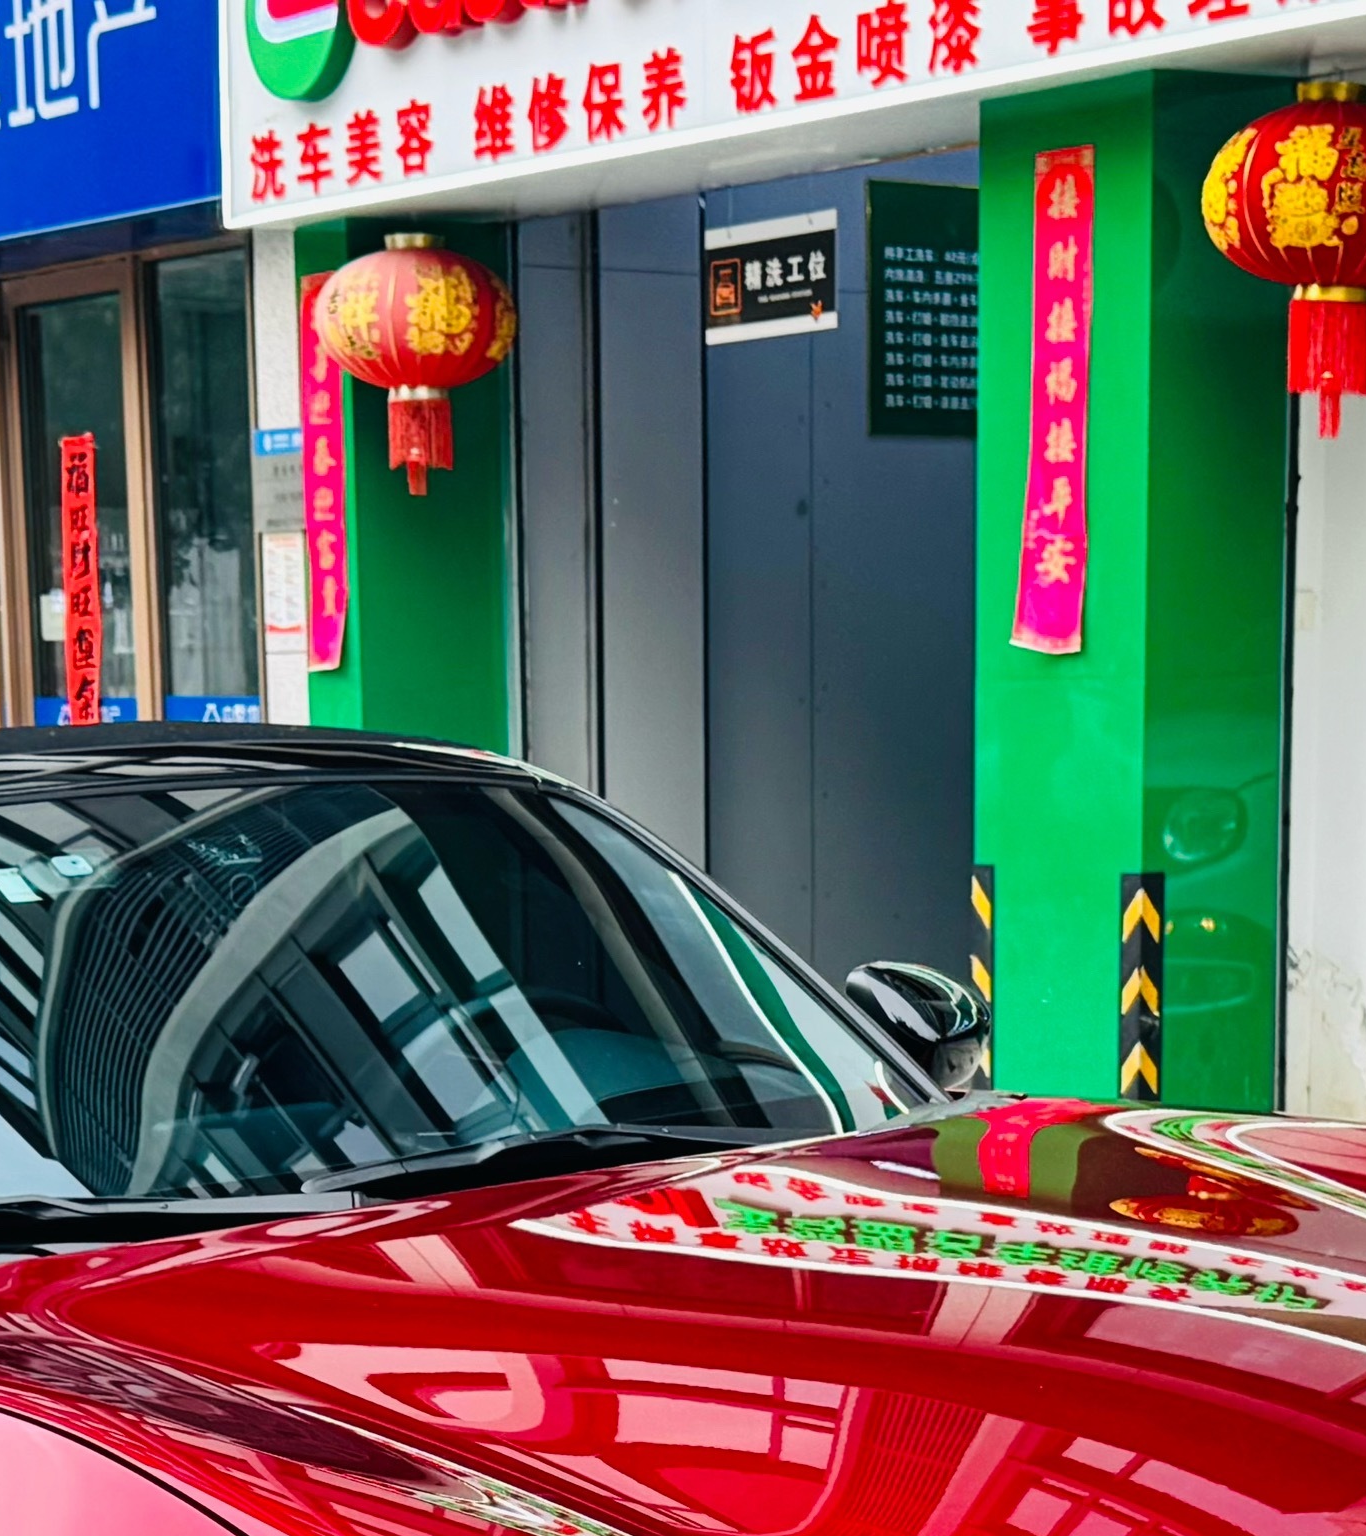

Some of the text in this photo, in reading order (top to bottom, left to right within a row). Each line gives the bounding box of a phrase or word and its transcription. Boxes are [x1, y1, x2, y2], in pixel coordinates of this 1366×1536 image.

[249, 99, 435, 204] 洗车美容
[473, 46, 688, 162] 维修保养
[729, 0, 982, 114] 钣金喷漆
